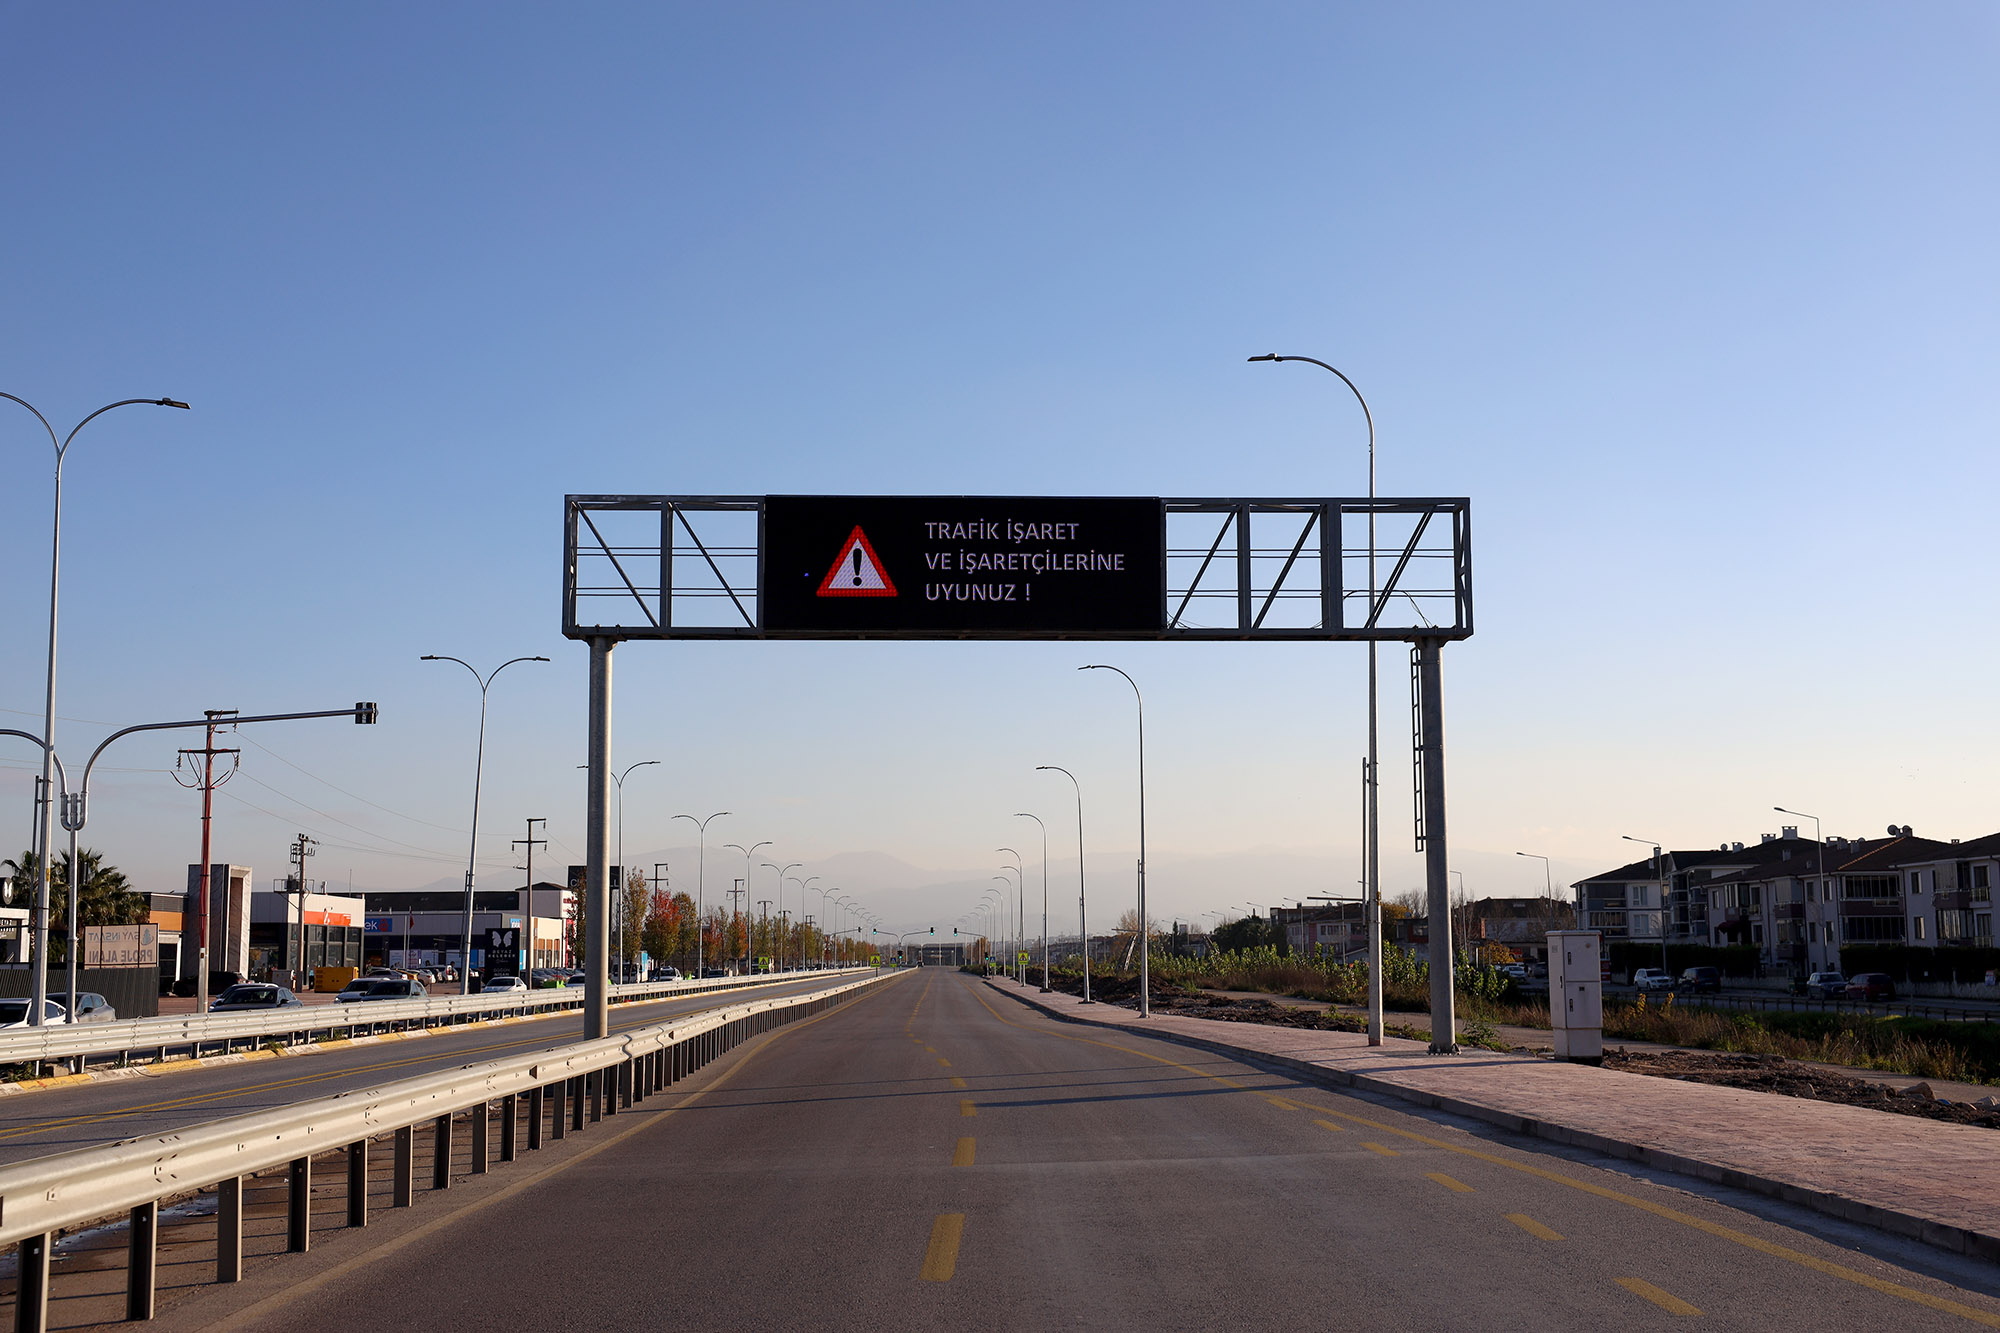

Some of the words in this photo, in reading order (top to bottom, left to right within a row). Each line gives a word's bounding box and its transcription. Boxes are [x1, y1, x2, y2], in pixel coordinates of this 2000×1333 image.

[925, 518, 999, 539] TRAFİK
[1007, 518, 1079, 544] İŞARET
[925, 553, 952, 570] VE
[960, 549, 1125, 575] İŞARETÇİLERİNE
[926, 584, 1016, 601] UYUNUZ
[1026, 583, 1031, 601] !
